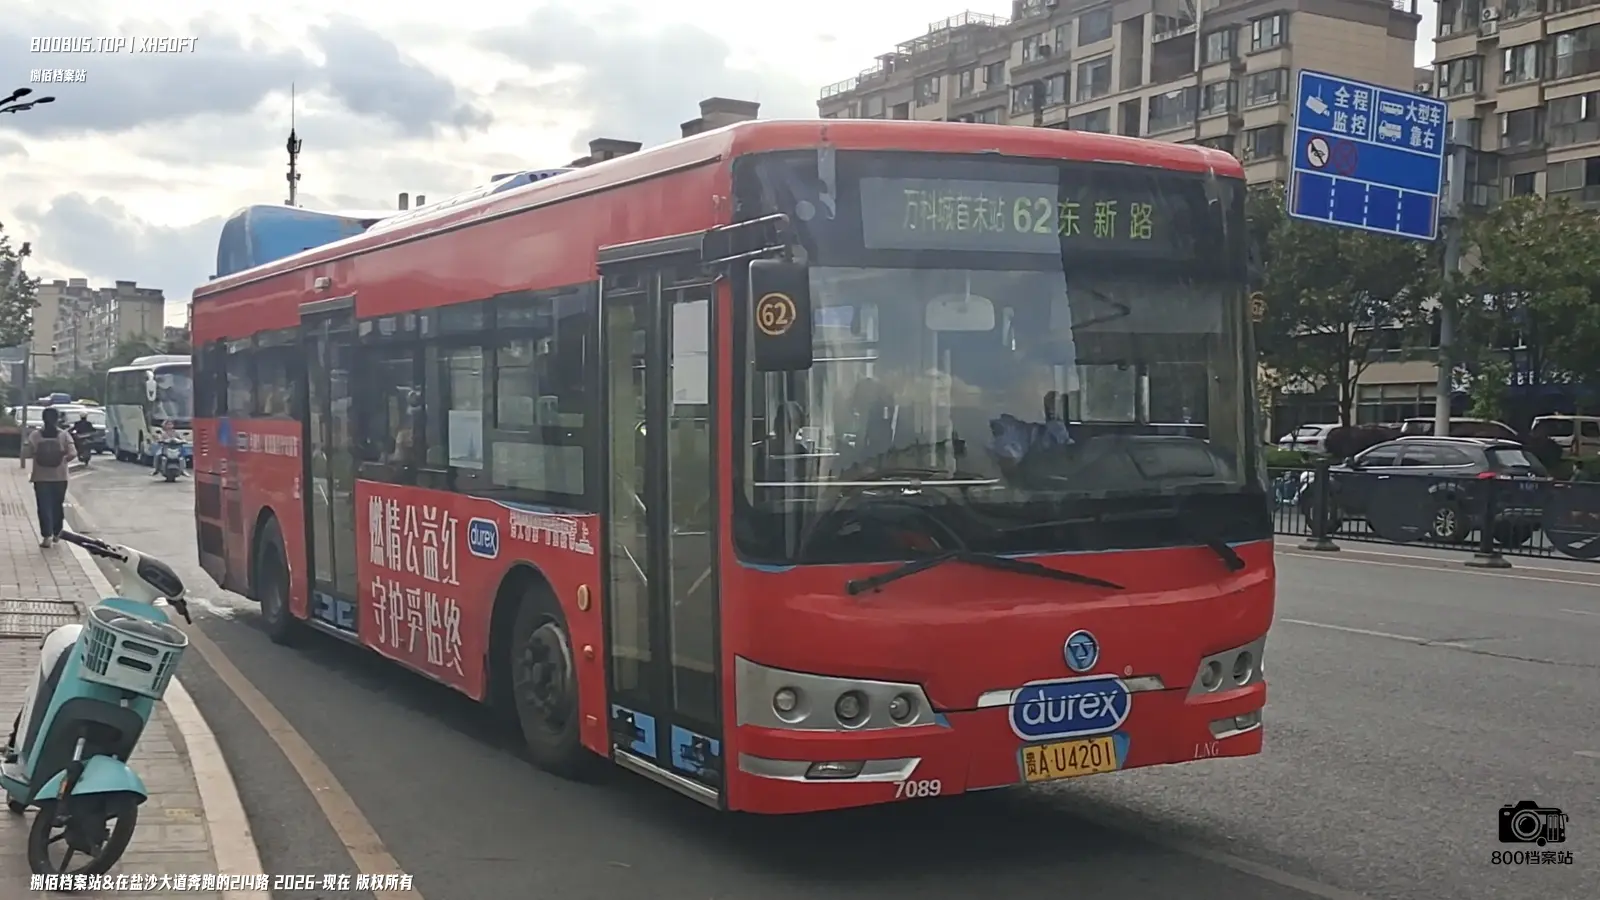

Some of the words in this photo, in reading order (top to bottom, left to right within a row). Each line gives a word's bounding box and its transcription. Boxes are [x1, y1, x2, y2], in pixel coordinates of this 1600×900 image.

[1333, 86, 1369, 112] 全程
[1332, 111, 1367, 136] 监控
[1405, 101, 1442, 127] 大型车
[1409, 126, 1436, 150] 靠右
[1012, 197, 1053, 234] 62
[1057, 198, 1153, 240] 东新路
[761, 301, 789, 327] 62
[470, 522, 497, 552] durex
[1022, 687, 1122, 726] durex
[1194, 741, 1220, 758] LNG
[893, 779, 942, 799] 7089
